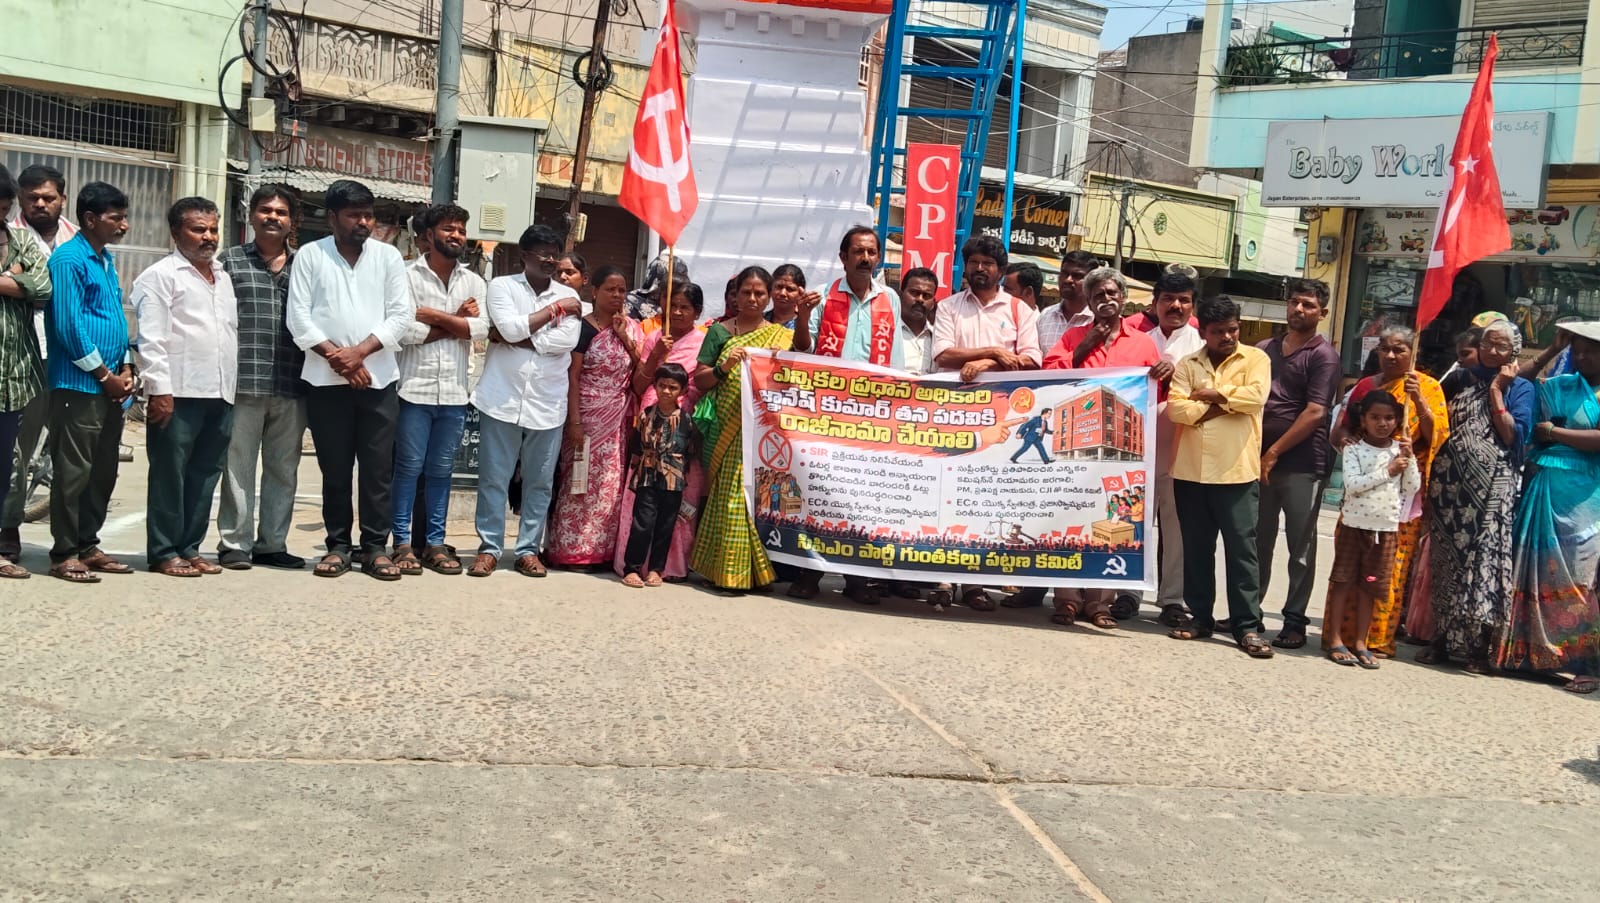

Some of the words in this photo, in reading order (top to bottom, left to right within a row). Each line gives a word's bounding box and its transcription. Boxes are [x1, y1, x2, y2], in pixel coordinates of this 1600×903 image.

[377, 147, 432, 182] STORES
[1288, 145, 1363, 184] Baby
[1024, 194, 1068, 227] Corner
[772, 366, 846, 392] ఎన్నికల
[849, 376, 912, 400] ప్రధాన
[915, 386, 993, 406] అధికారి
[820, 397, 891, 421] కుమార్
[895, 406, 929, 424] తన
[933, 407, 997, 427] పదవికి
[779, 412, 892, 444] రాజీనామా
[896, 423, 976, 450] చేయాలి
[809, 447, 828, 457] SIR
[863, 468, 887, 477] నుండి
[1039, 486, 1053, 494] CJI
[796, 533, 854, 557] సిపిఎం
[858, 540, 896, 567] పార్టీ
[900, 545, 982, 571] గుంతకల్లు
[985, 551, 1031, 573] పట్టణ
[1035, 550, 1082, 572] కమిటీ
